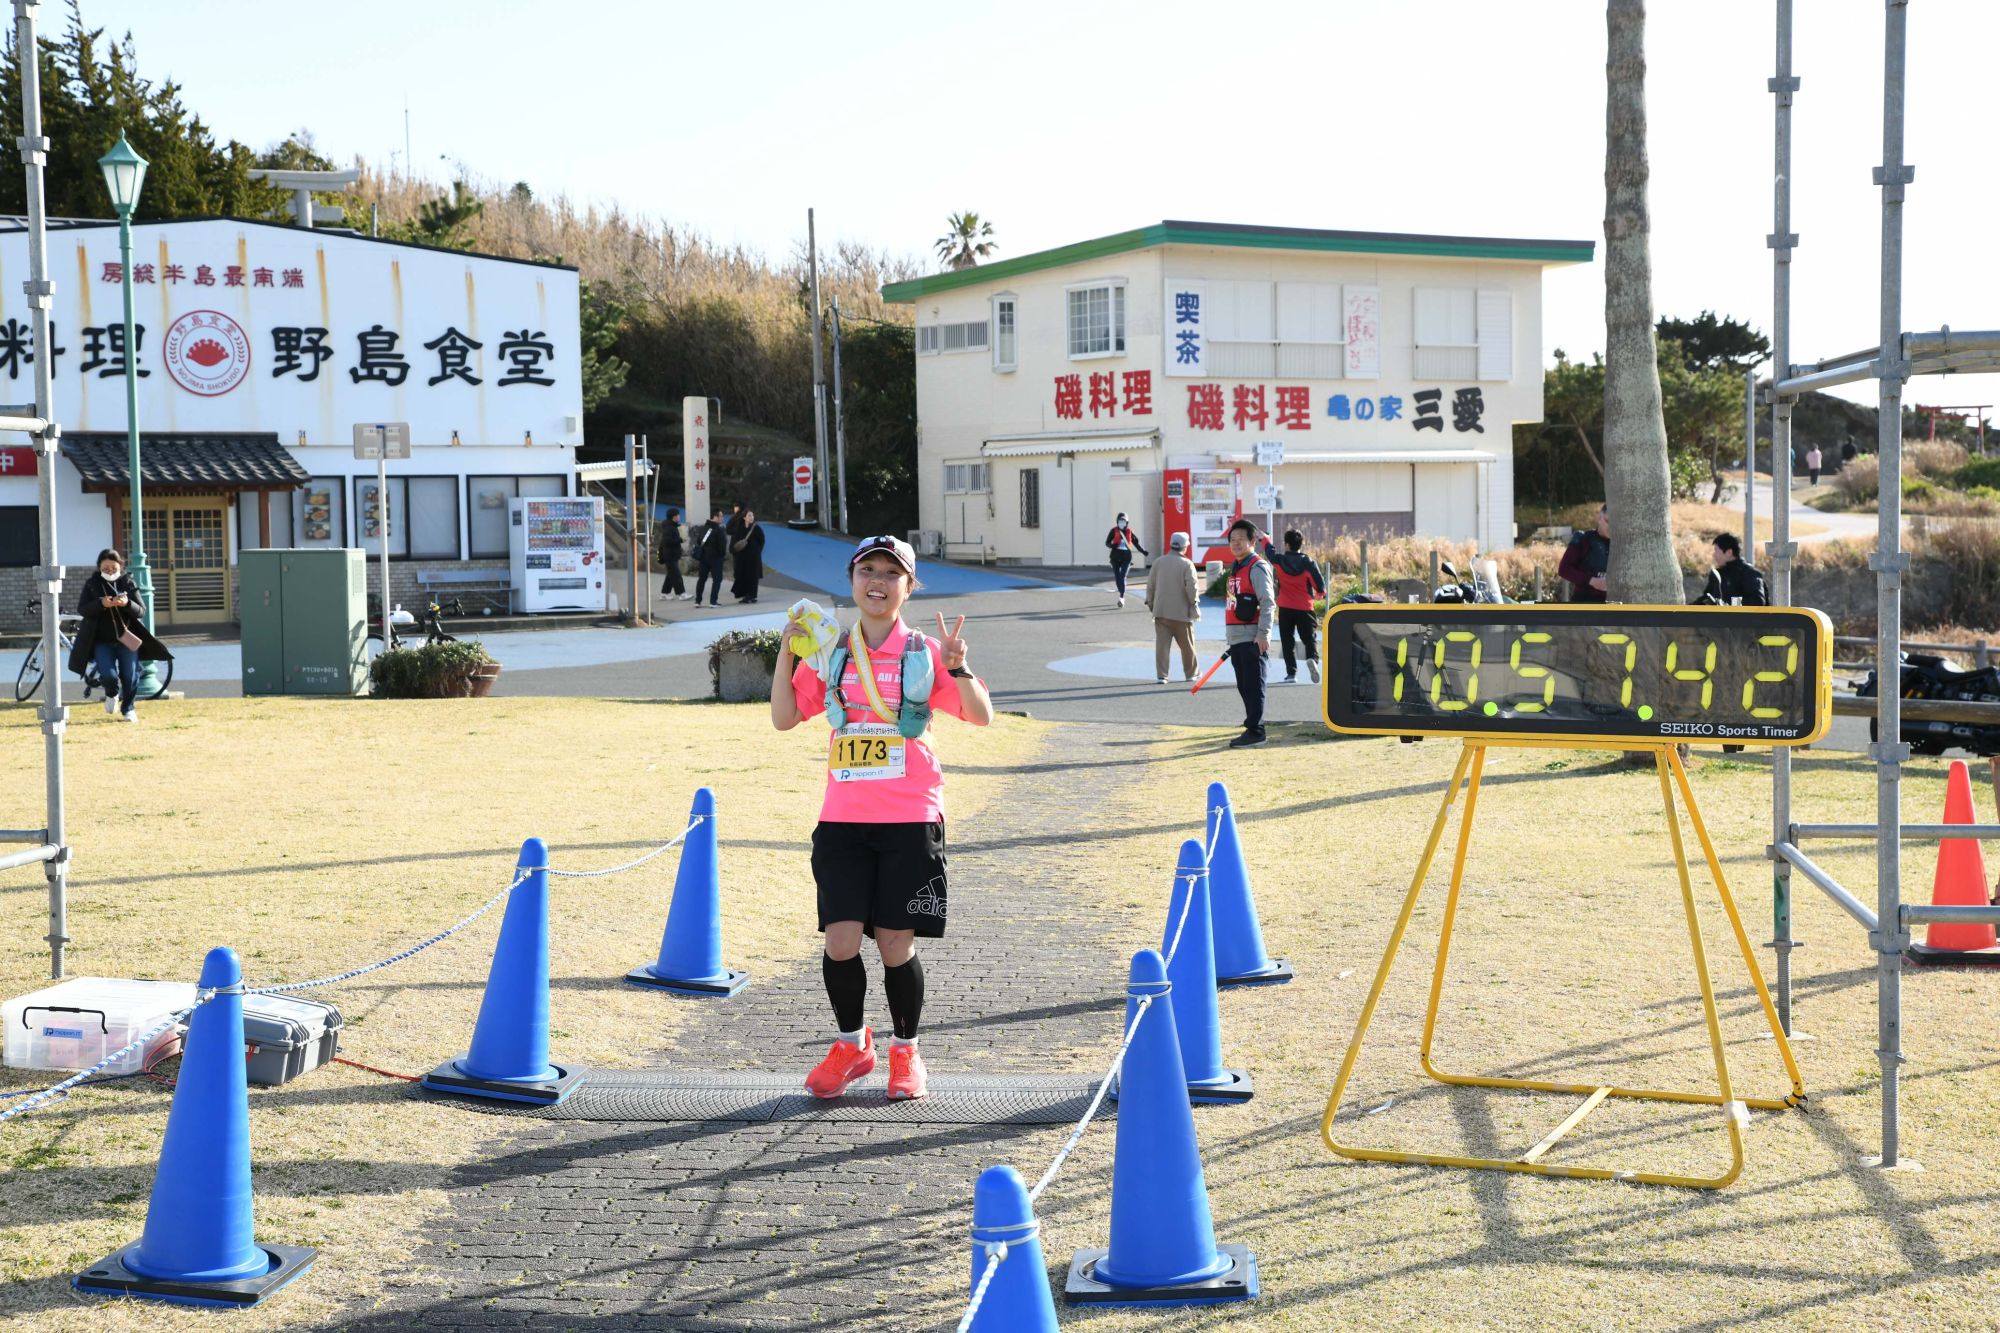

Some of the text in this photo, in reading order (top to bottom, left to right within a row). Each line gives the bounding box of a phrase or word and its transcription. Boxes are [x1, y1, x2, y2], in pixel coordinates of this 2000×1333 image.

[101, 262, 304, 288] 房総半島最南端
[1175, 291, 1200, 364] 喫茶
[271, 325, 555, 387] 野島食堂
[176, 367, 241, 390] NOJIMA SHOKUDO
[1054, 370, 1152, 420] 磯料理
[1187, 383, 1311, 431] 磯料理
[1328, 393, 1403, 421] 亀の家
[1660, 723, 1798, 737] SEIKO Sports Timer
[839, 739, 887, 762] 1173
